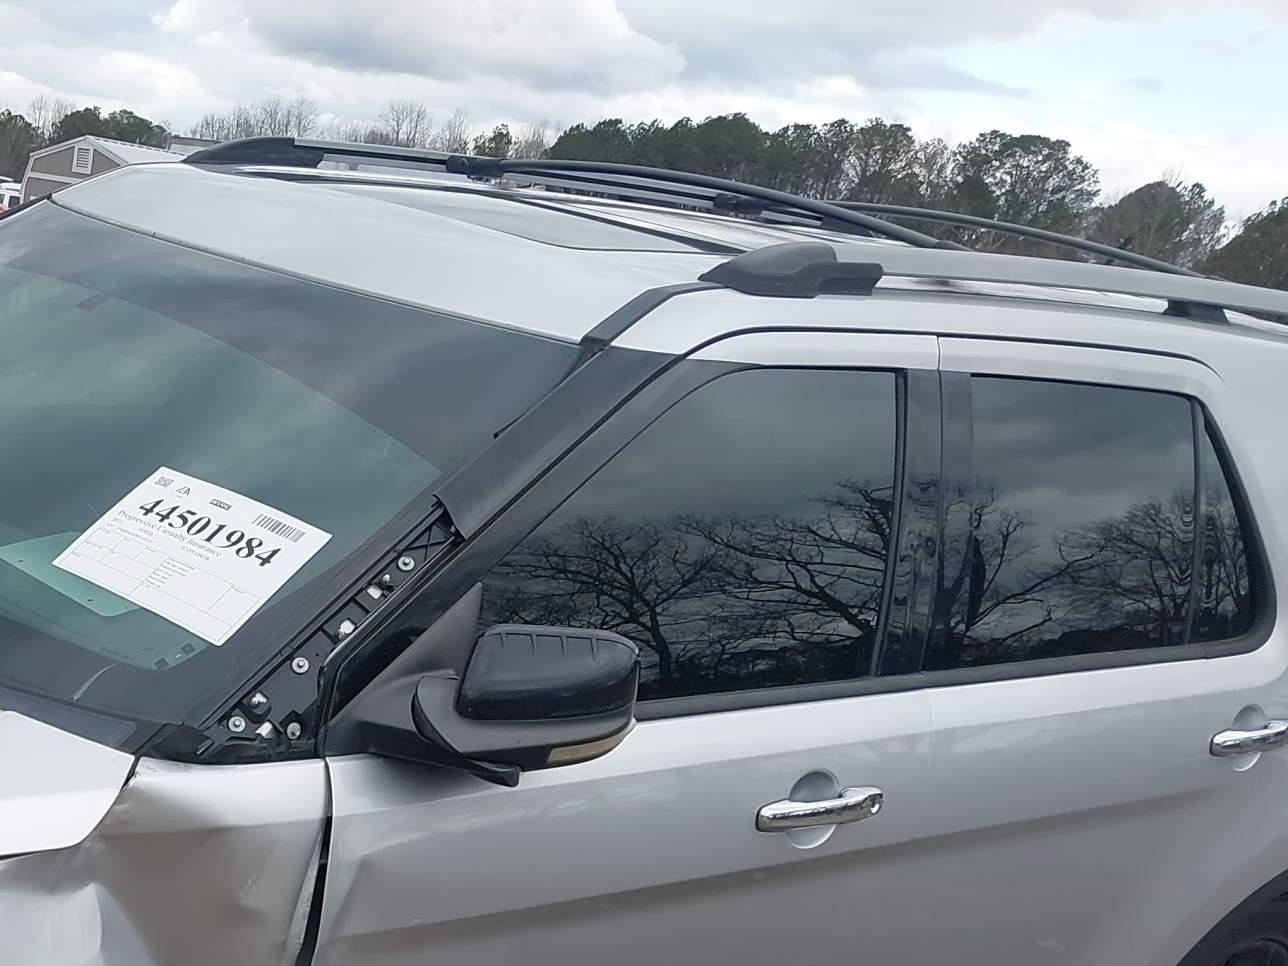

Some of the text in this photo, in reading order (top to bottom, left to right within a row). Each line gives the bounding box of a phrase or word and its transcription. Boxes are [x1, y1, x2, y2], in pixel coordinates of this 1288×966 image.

[118, 509, 155, 530] Progressive
[157, 525, 187, 543] Casualty
[187, 537, 223, 557] Insurance
[139, 498, 282, 567] 44501984
